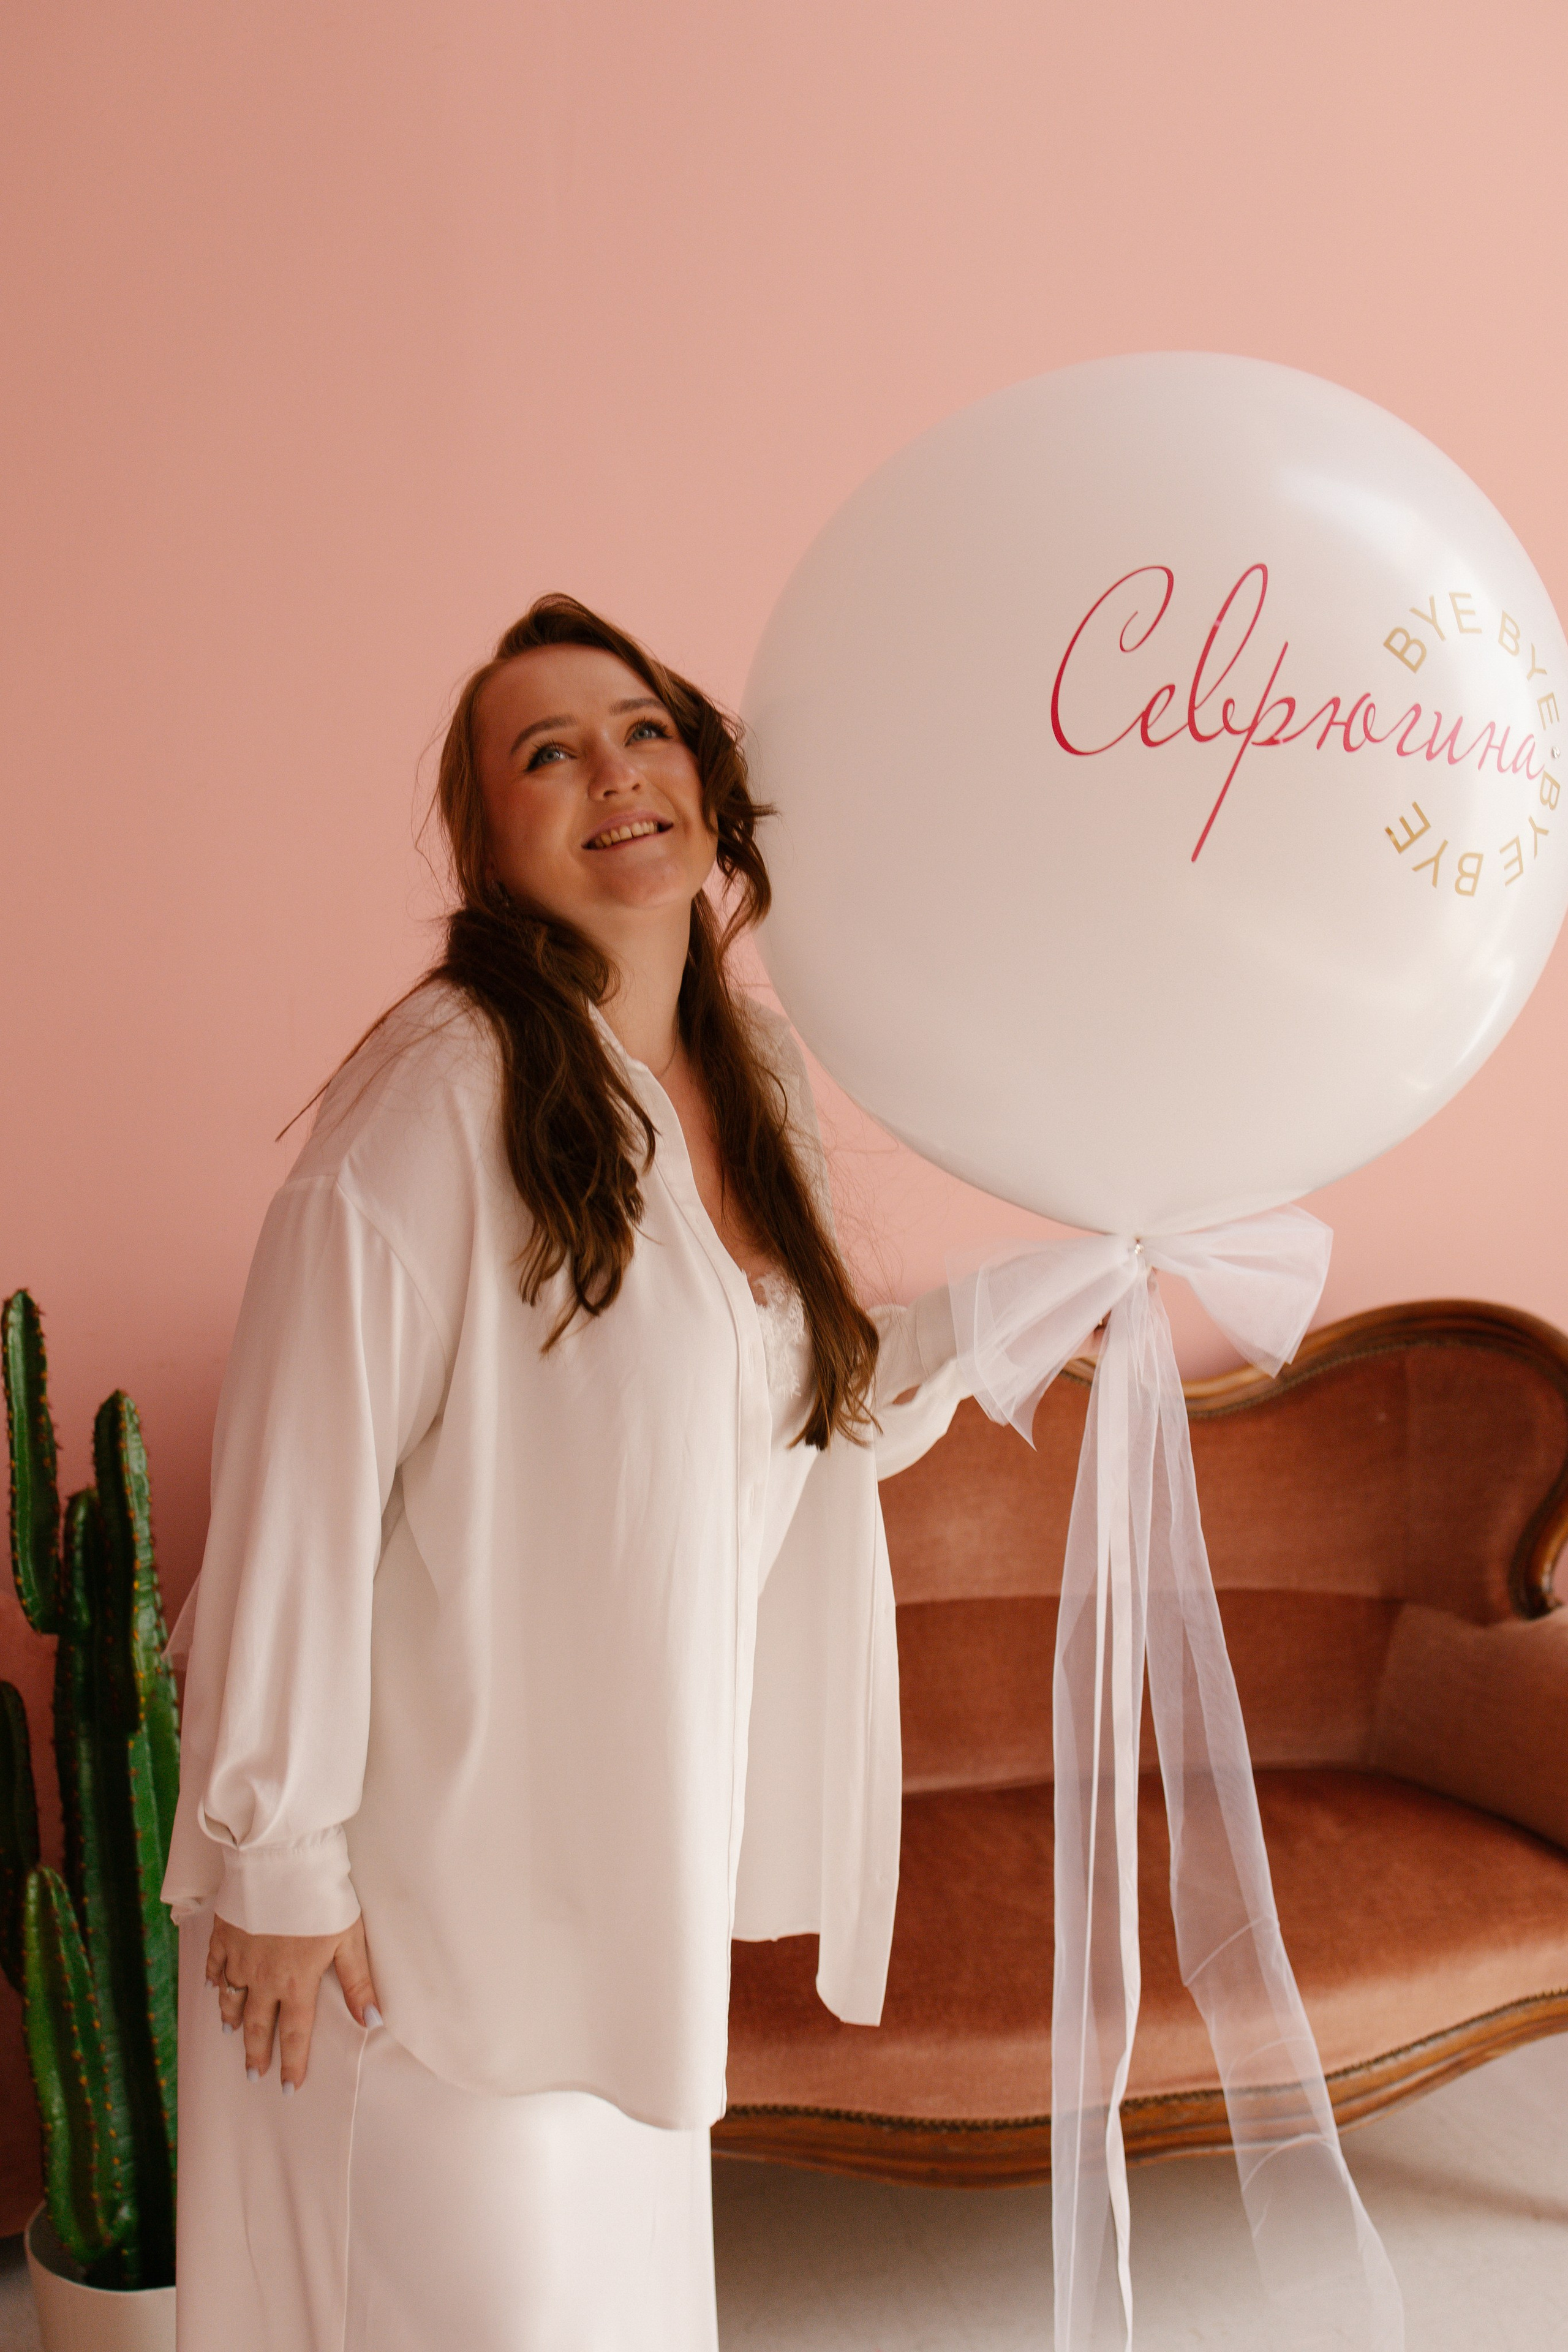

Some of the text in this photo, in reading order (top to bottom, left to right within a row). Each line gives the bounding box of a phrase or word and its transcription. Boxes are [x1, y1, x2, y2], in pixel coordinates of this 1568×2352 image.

[1051, 563, 1545, 862] Севрюгина
[1383, 592, 1561, 897] BYE BYE BYE BYE
